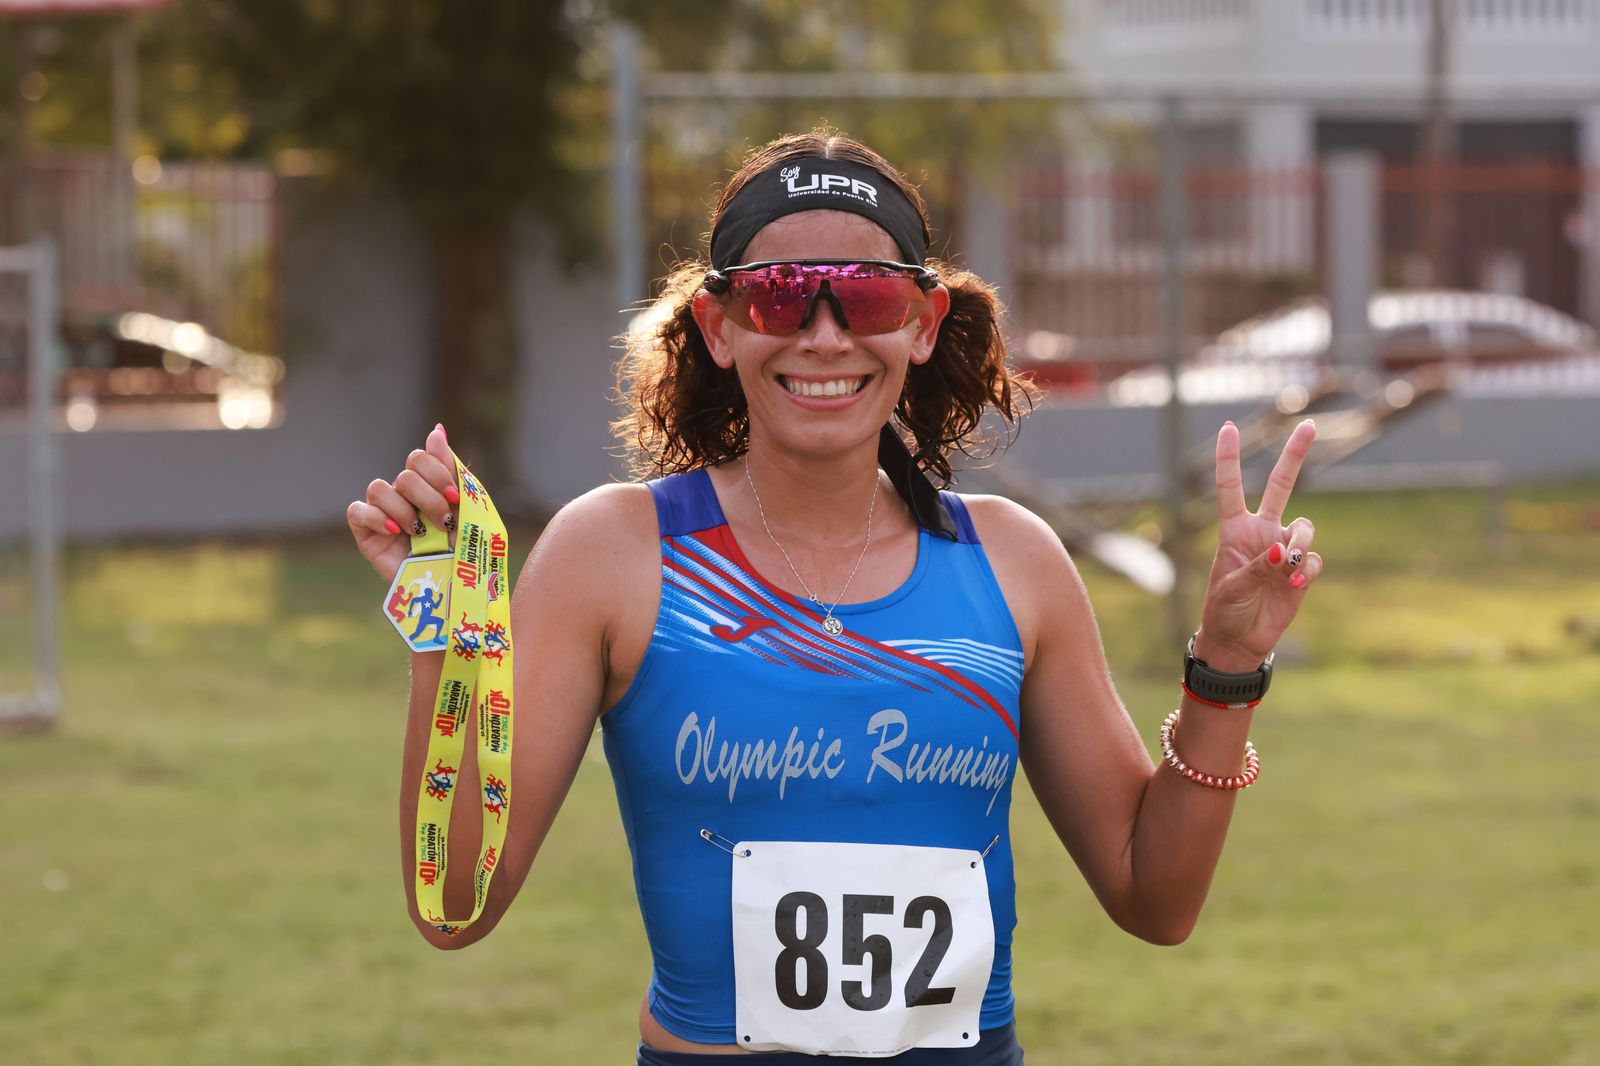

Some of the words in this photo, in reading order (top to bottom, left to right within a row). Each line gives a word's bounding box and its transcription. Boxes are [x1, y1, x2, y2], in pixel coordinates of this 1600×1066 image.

[780, 166, 801, 183] Soy
[787, 174, 878, 203] UPR
[788, 189, 830, 198] Universidad
[842, 191, 864, 201] Puerto
[865, 198, 879, 208] Rico
[467, 523, 479, 564] MARATÓN
[490, 532, 506, 557] 10K
[456, 560, 477, 590] 10K
[446, 680, 462, 715] MARATÓN
[490, 689, 510, 716] 10K
[436, 713, 456, 738] 10K
[489, 714, 500, 752] MARATÓN
[675, 711, 845, 803] Olympic
[866, 709, 1010, 816] Running
[427, 823, 438, 862] MARATÓN
[419, 862, 436, 886] 10K
[482, 847, 497, 874] 10K
[775, 891, 956, 1012] 852
